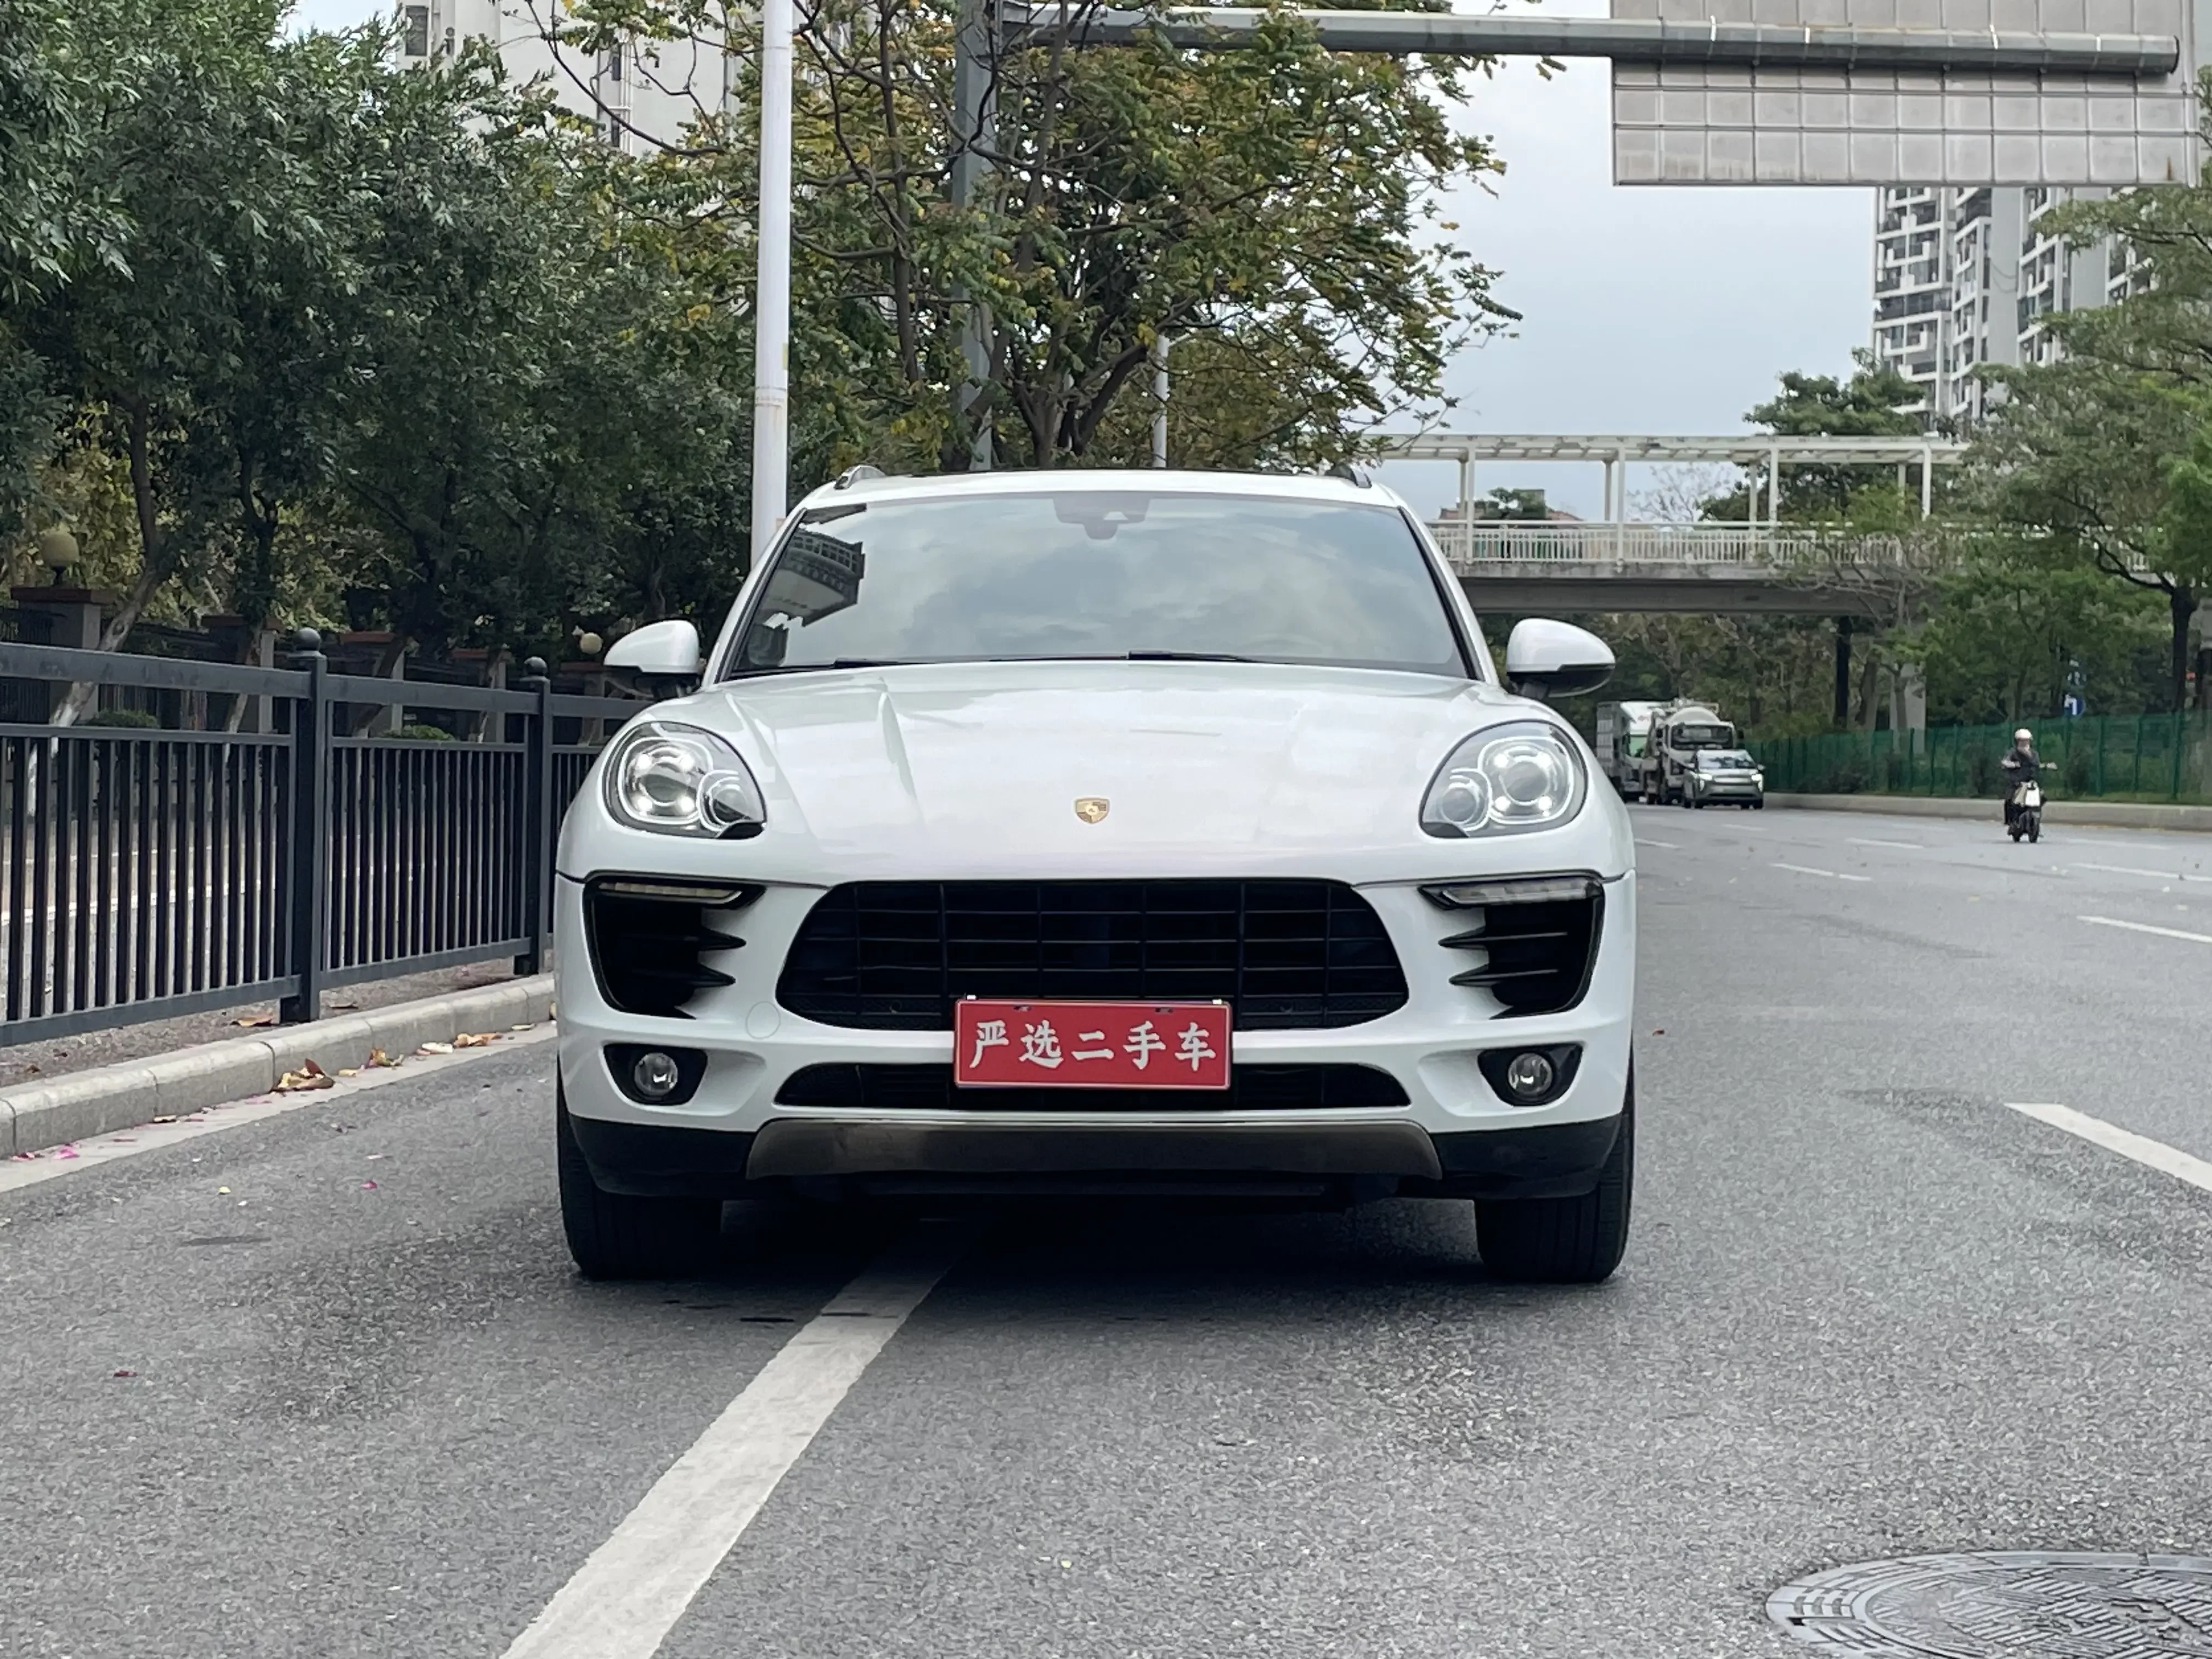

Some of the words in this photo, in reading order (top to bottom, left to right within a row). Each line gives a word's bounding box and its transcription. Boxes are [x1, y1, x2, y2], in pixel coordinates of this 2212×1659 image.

[969, 1020, 1216, 1071] 严选二手车
